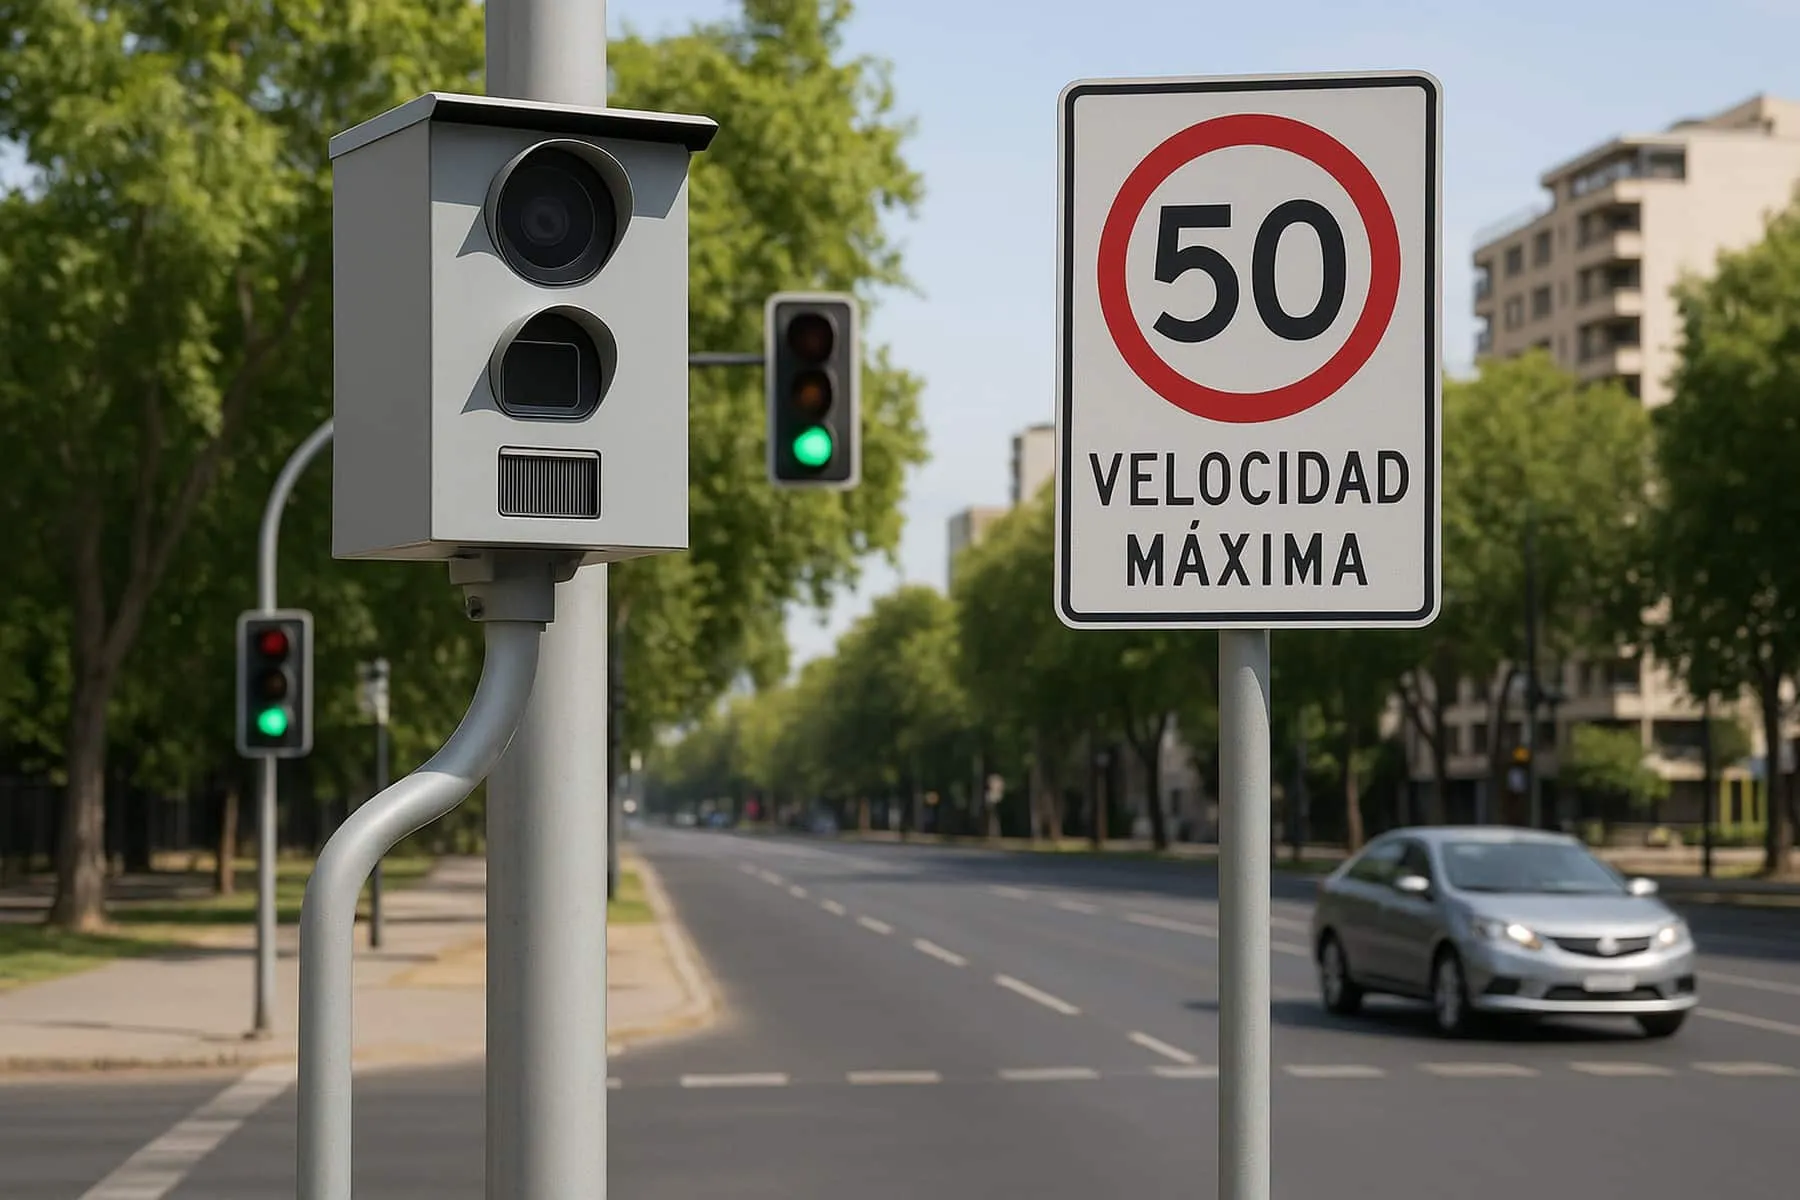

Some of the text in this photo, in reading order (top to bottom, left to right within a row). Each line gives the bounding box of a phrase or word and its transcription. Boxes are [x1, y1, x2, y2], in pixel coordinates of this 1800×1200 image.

[1152, 198, 1347, 344] 50
[1088, 449, 1411, 508] VELOCIDAD
[1125, 518, 1370, 588] MÁXIMA
